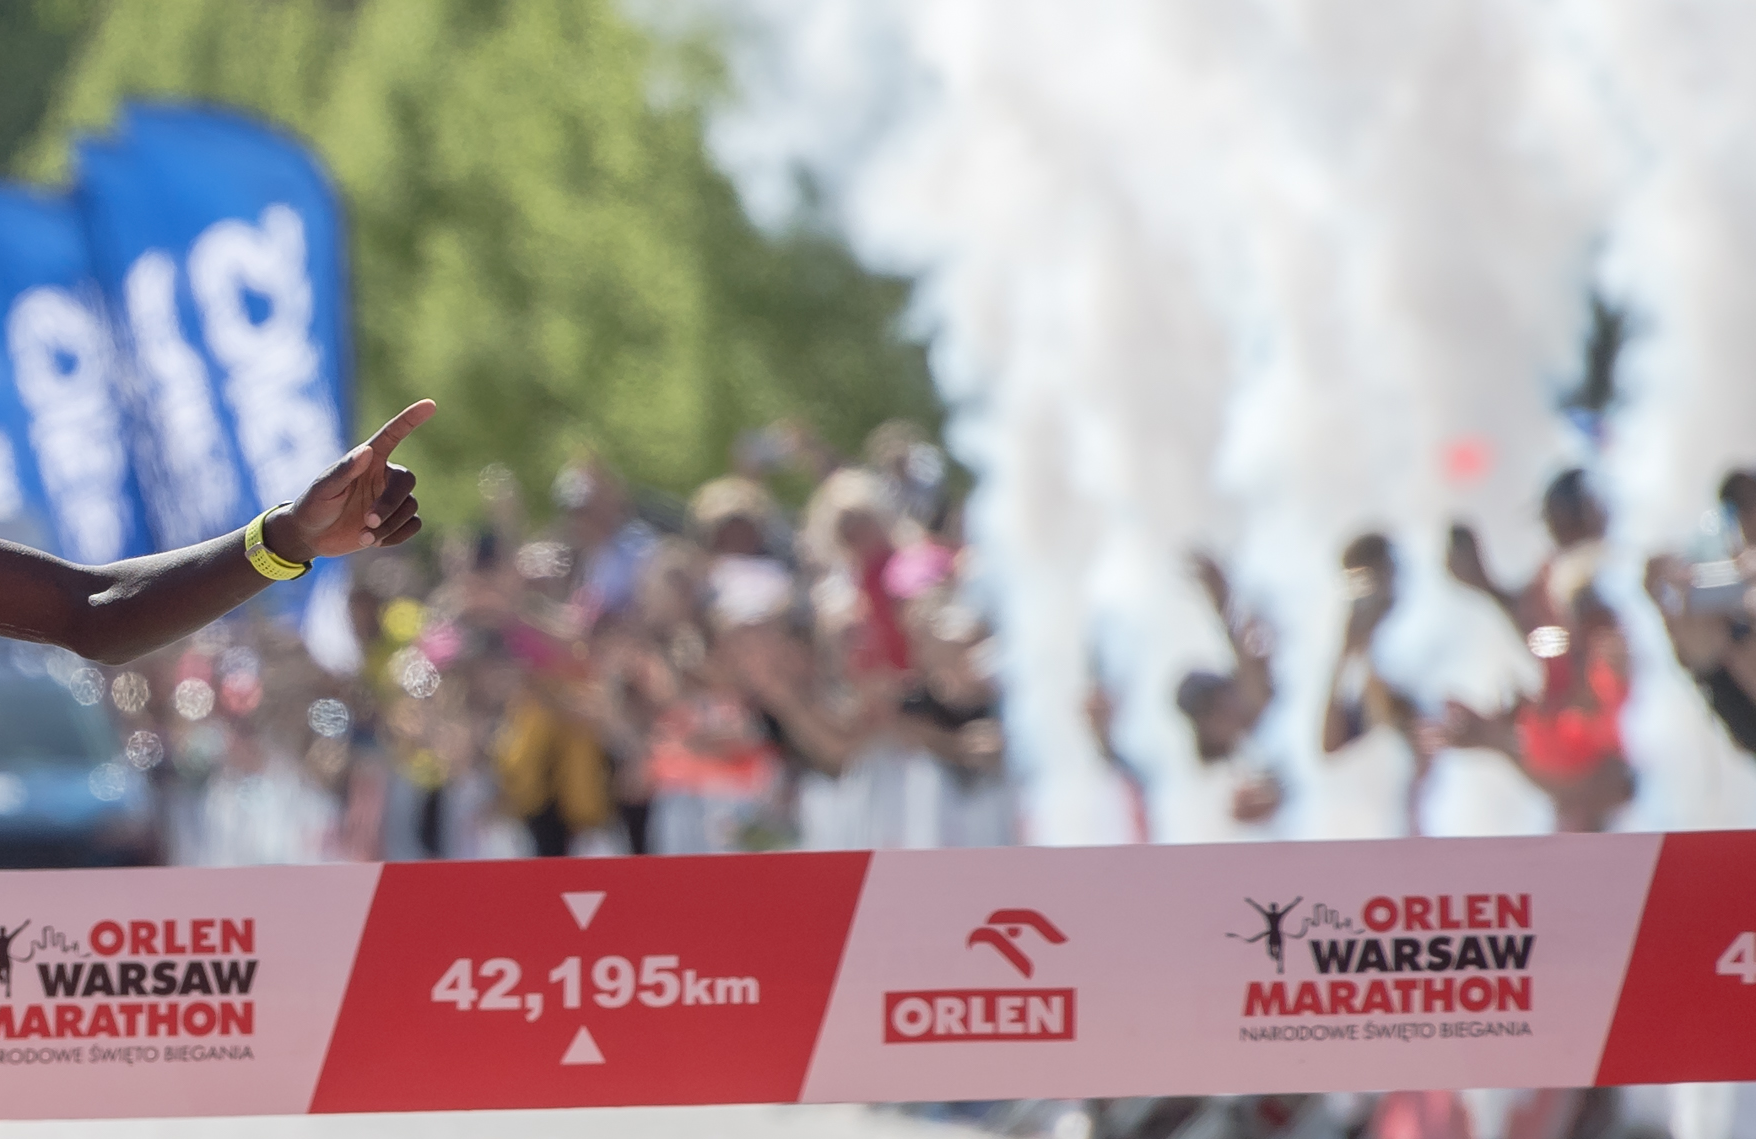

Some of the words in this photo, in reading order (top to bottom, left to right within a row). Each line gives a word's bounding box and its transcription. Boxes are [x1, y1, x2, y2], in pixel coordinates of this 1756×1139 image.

[1363, 894, 1532, 932] ORLEN
[89, 919, 254, 956] ORLEN
[1309, 935, 1536, 974] WARSAW
[37, 960, 258, 997] WARSAW
[432, 956, 760, 1021] 42,195km
[1243, 976, 1532, 1016] MARATHON
[892, 996, 1065, 1036] ORLEN
[1239, 1024, 1357, 1041] NARODOWE
[1363, 1020, 1436, 1042] ŚWIĘTO
[1440, 1021, 1532, 1038] BIEGANIA
[89, 1043, 159, 1066] ŚWIĘTO
[164, 1045, 254, 1062] BIEGANIA
